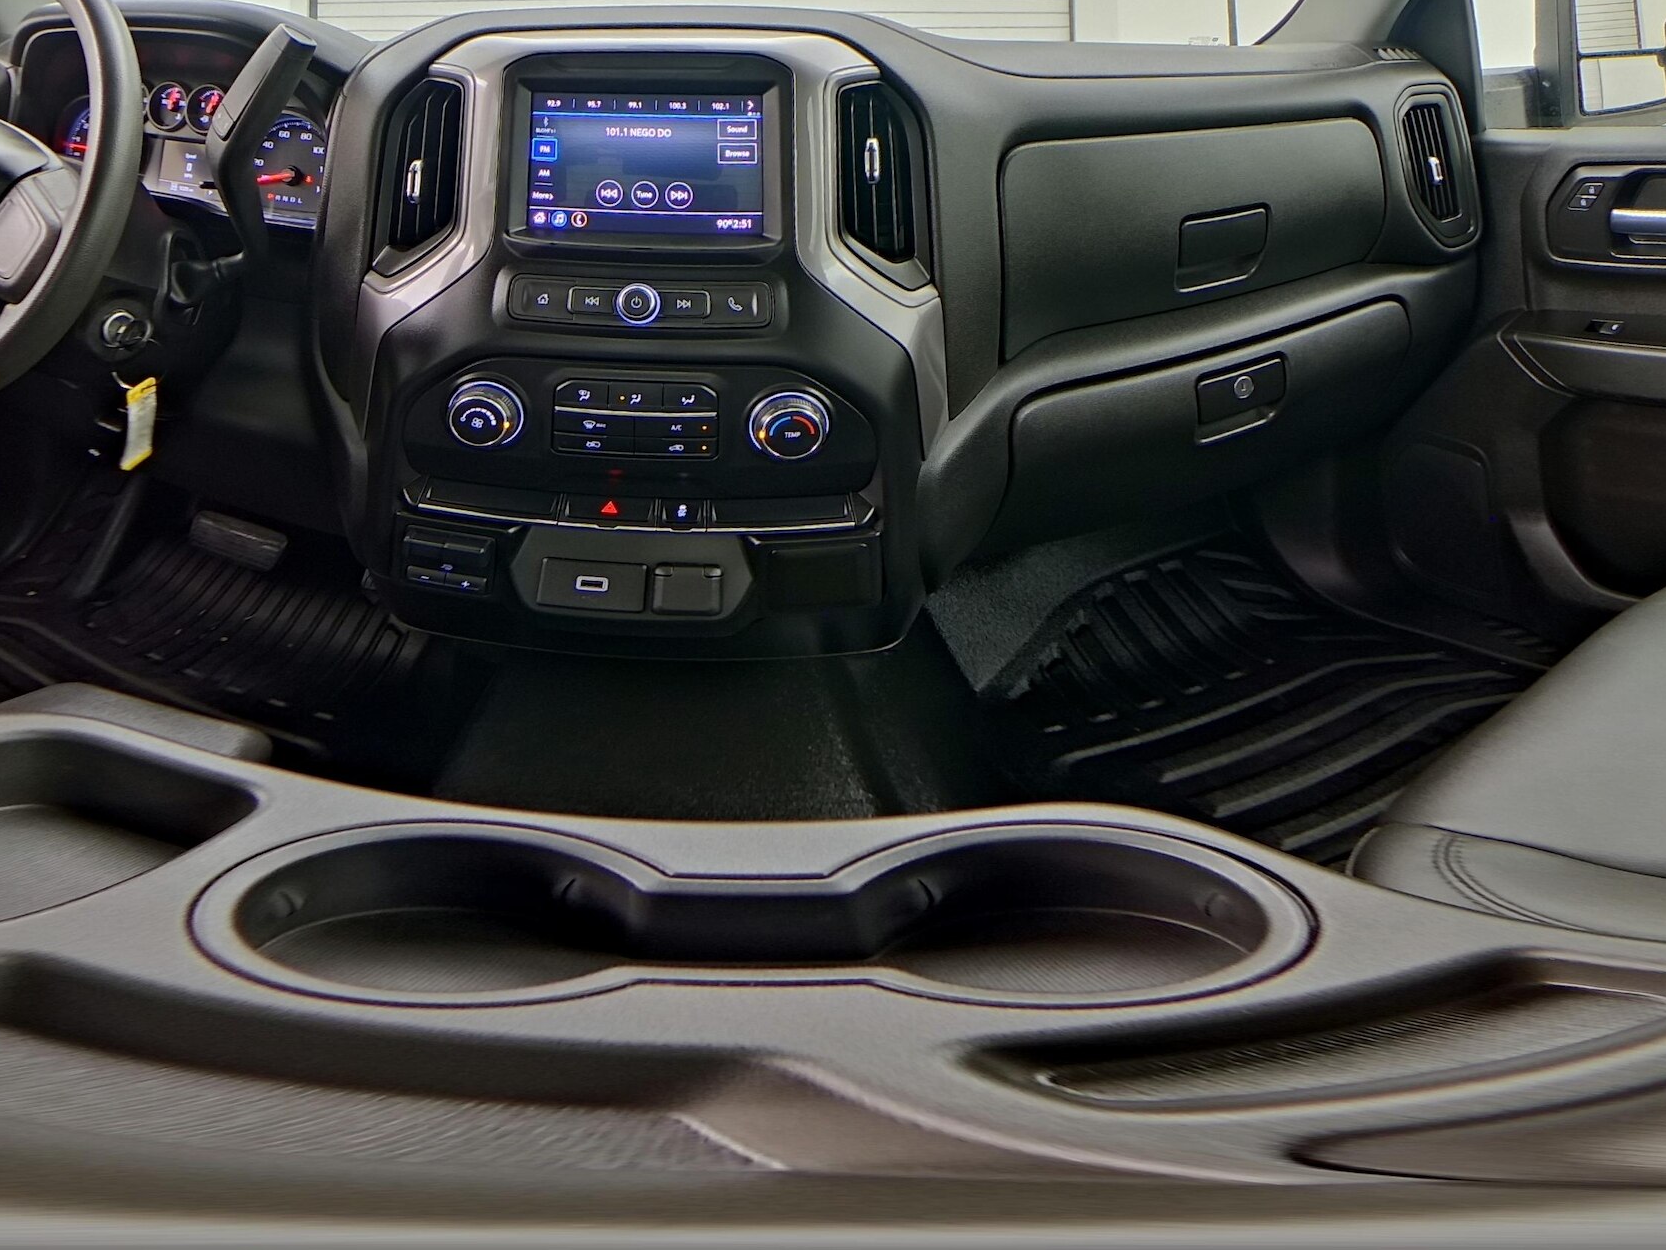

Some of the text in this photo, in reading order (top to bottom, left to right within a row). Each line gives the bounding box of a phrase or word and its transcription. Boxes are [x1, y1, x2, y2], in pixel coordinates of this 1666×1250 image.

[605, 126, 628, 137] 101.1
[630, 128, 656, 138] NEGO
[726, 125, 748, 134] Sound
[278, 130, 291, 139] 60
[300, 133, 313, 141] 80
[263, 141, 274, 149] 40
[539, 145, 551, 153] FM
[725, 150, 750, 158] Browse
[537, 169, 551, 178] AM
[635, 190, 653, 199] Tune
